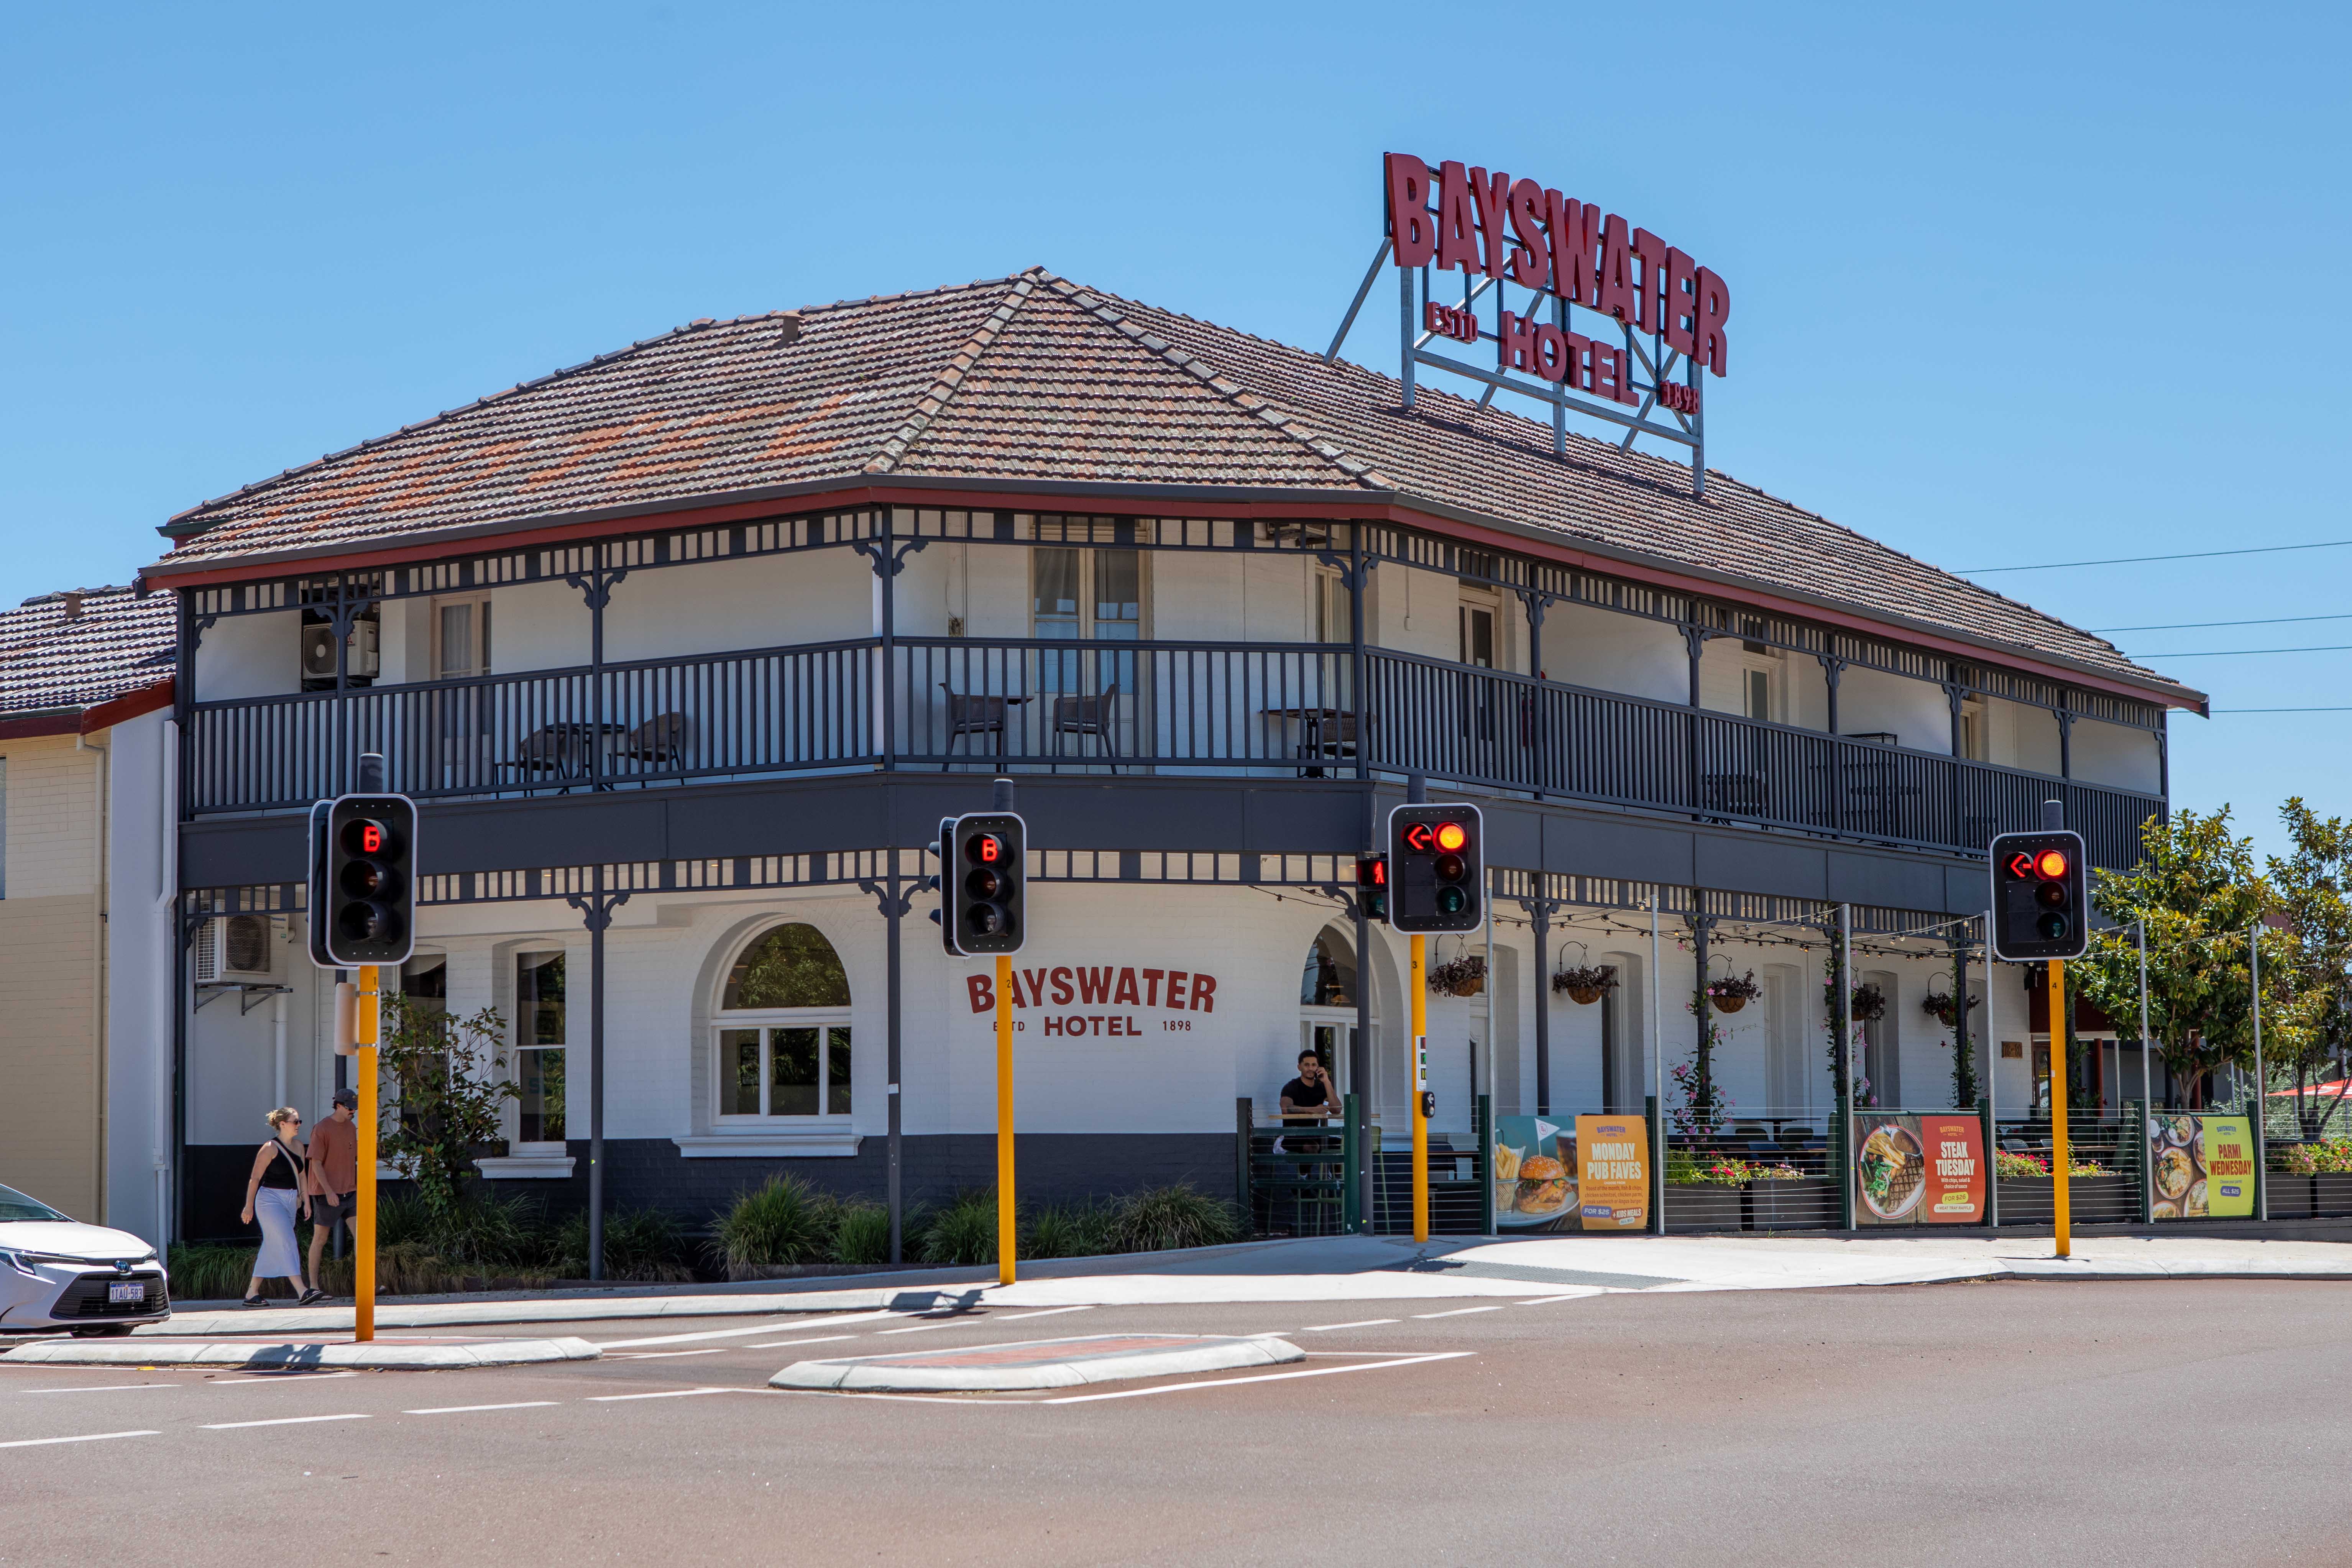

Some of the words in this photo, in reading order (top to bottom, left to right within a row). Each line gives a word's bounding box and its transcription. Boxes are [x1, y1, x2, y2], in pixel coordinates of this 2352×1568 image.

[1385, 153, 1730, 378] BAYSWATER
[1426, 301, 1478, 343] ESTD
[1501, 310, 1639, 407] HOTEL
[1661, 379, 1700, 415] 1898
[363, 826, 381, 852] B
[982, 839, 998, 861] B
[1413, 961, 1417, 969] 3
[373, 977, 376, 985] 1
[1006, 979, 1011, 988] 2
[993, 1021, 1025, 1031] ETD
[1045, 1016, 1142, 1037] HOTEL
[1163, 1021, 1191, 1031] 1898
[1596, 1125, 1626, 1133] BAYSWATER
[1592, 1143, 1635, 1161] MONDAY
[1941, 1141, 1968, 1159] STEAK
[2217, 1144, 2242, 1159] PARMI
[1587, 1162, 1609, 1180] PUB
[1610, 1161, 1642, 1179] FAVES
[1936, 1159, 1975, 1176] TUESDAY
[2209, 1160, 2252, 1176] WEDNESDAY
[1616, 1210, 1627, 1218] KIDS
[1627, 1208, 1641, 1217] MEALS
